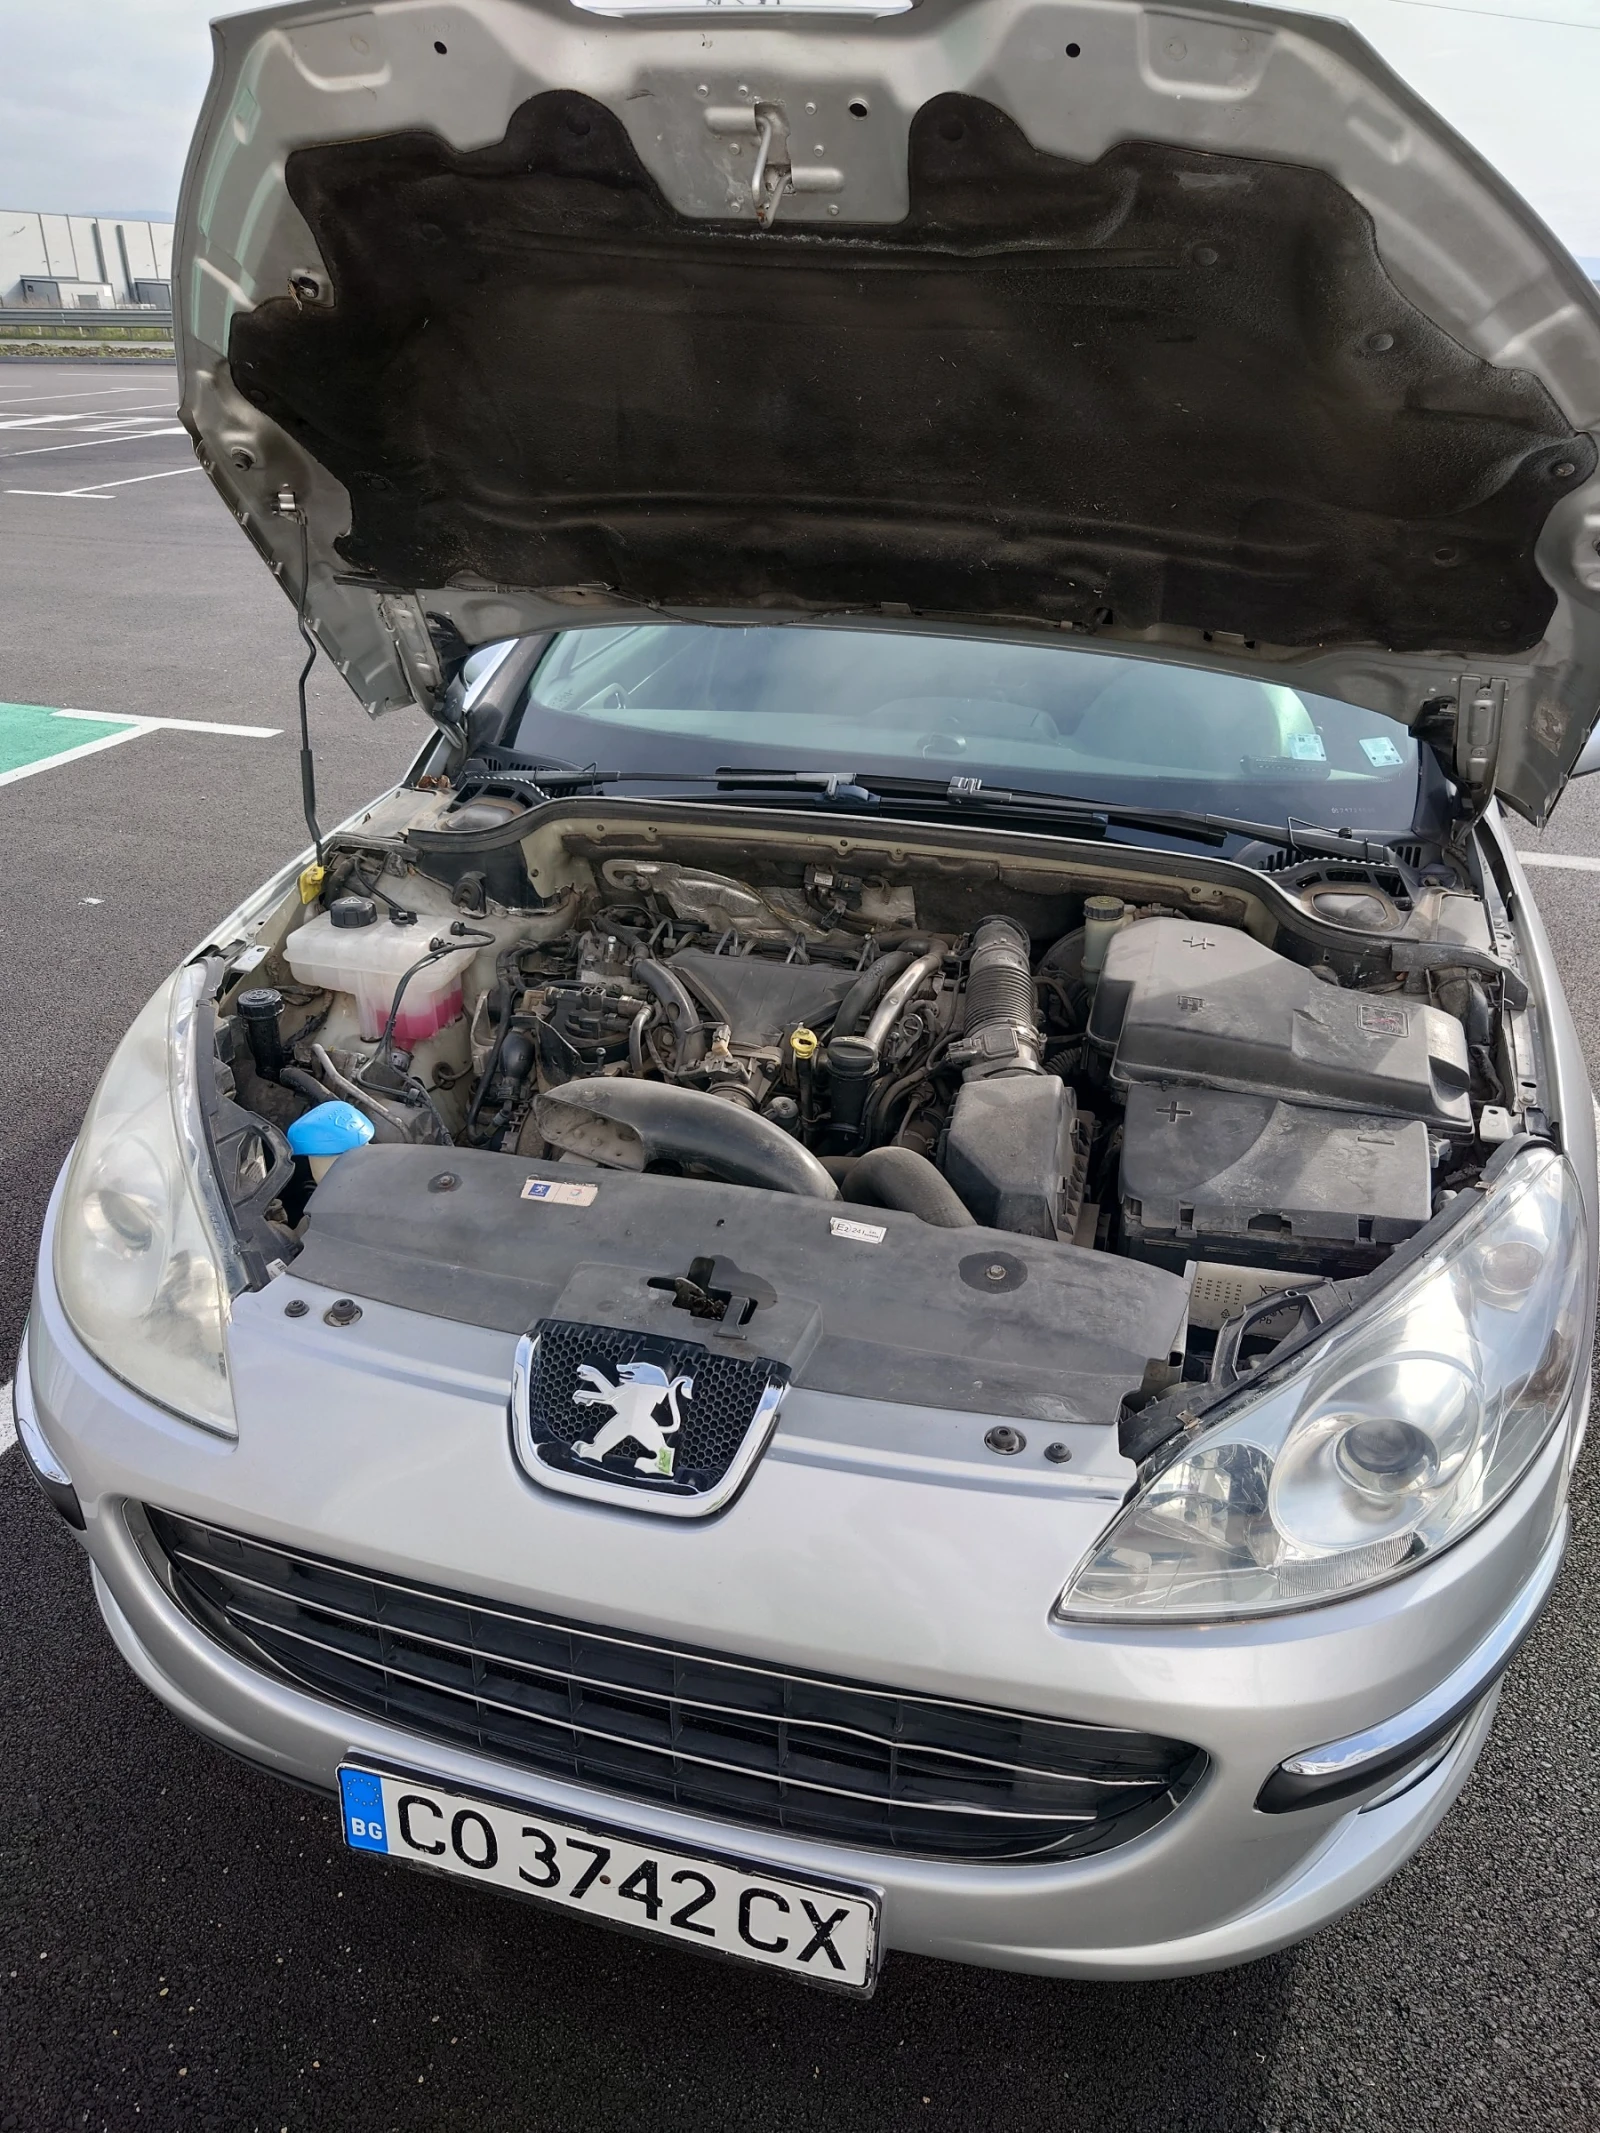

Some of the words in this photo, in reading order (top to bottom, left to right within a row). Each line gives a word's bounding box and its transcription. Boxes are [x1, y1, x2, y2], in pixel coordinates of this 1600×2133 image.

[350, 1817, 383, 1841] BG
[397, 1794, 498, 1870] CO
[518, 1826, 717, 1938] 3742
[738, 1887, 850, 1971] CX
